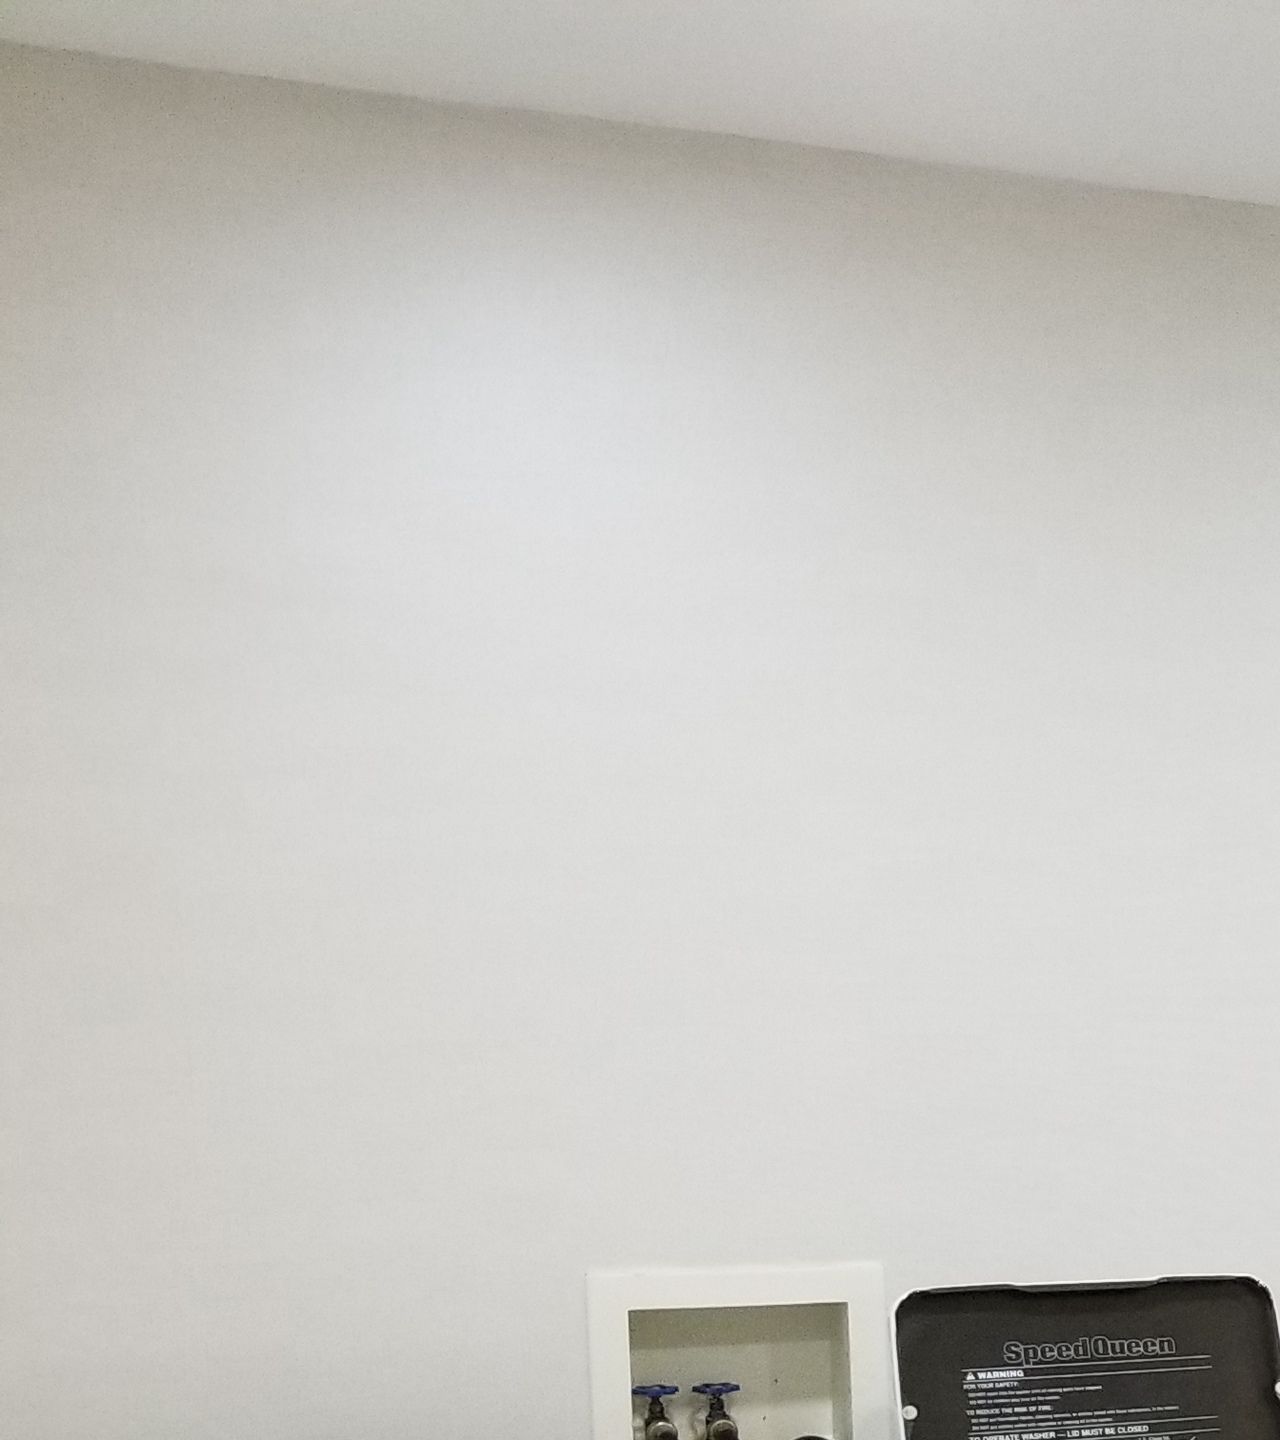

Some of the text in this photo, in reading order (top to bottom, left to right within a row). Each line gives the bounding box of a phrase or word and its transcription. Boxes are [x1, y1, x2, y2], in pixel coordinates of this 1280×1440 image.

[1003, 1336, 1176, 1367] Speed Queen
[977, 1370, 1024, 1380] WARNING
[1066, 1430, 1079, 1438] LID
[1081, 1427, 1103, 1437] MUST
[1104, 1426, 1116, 1435] BE
[1117, 1425, 1149, 1434] CLOSED
